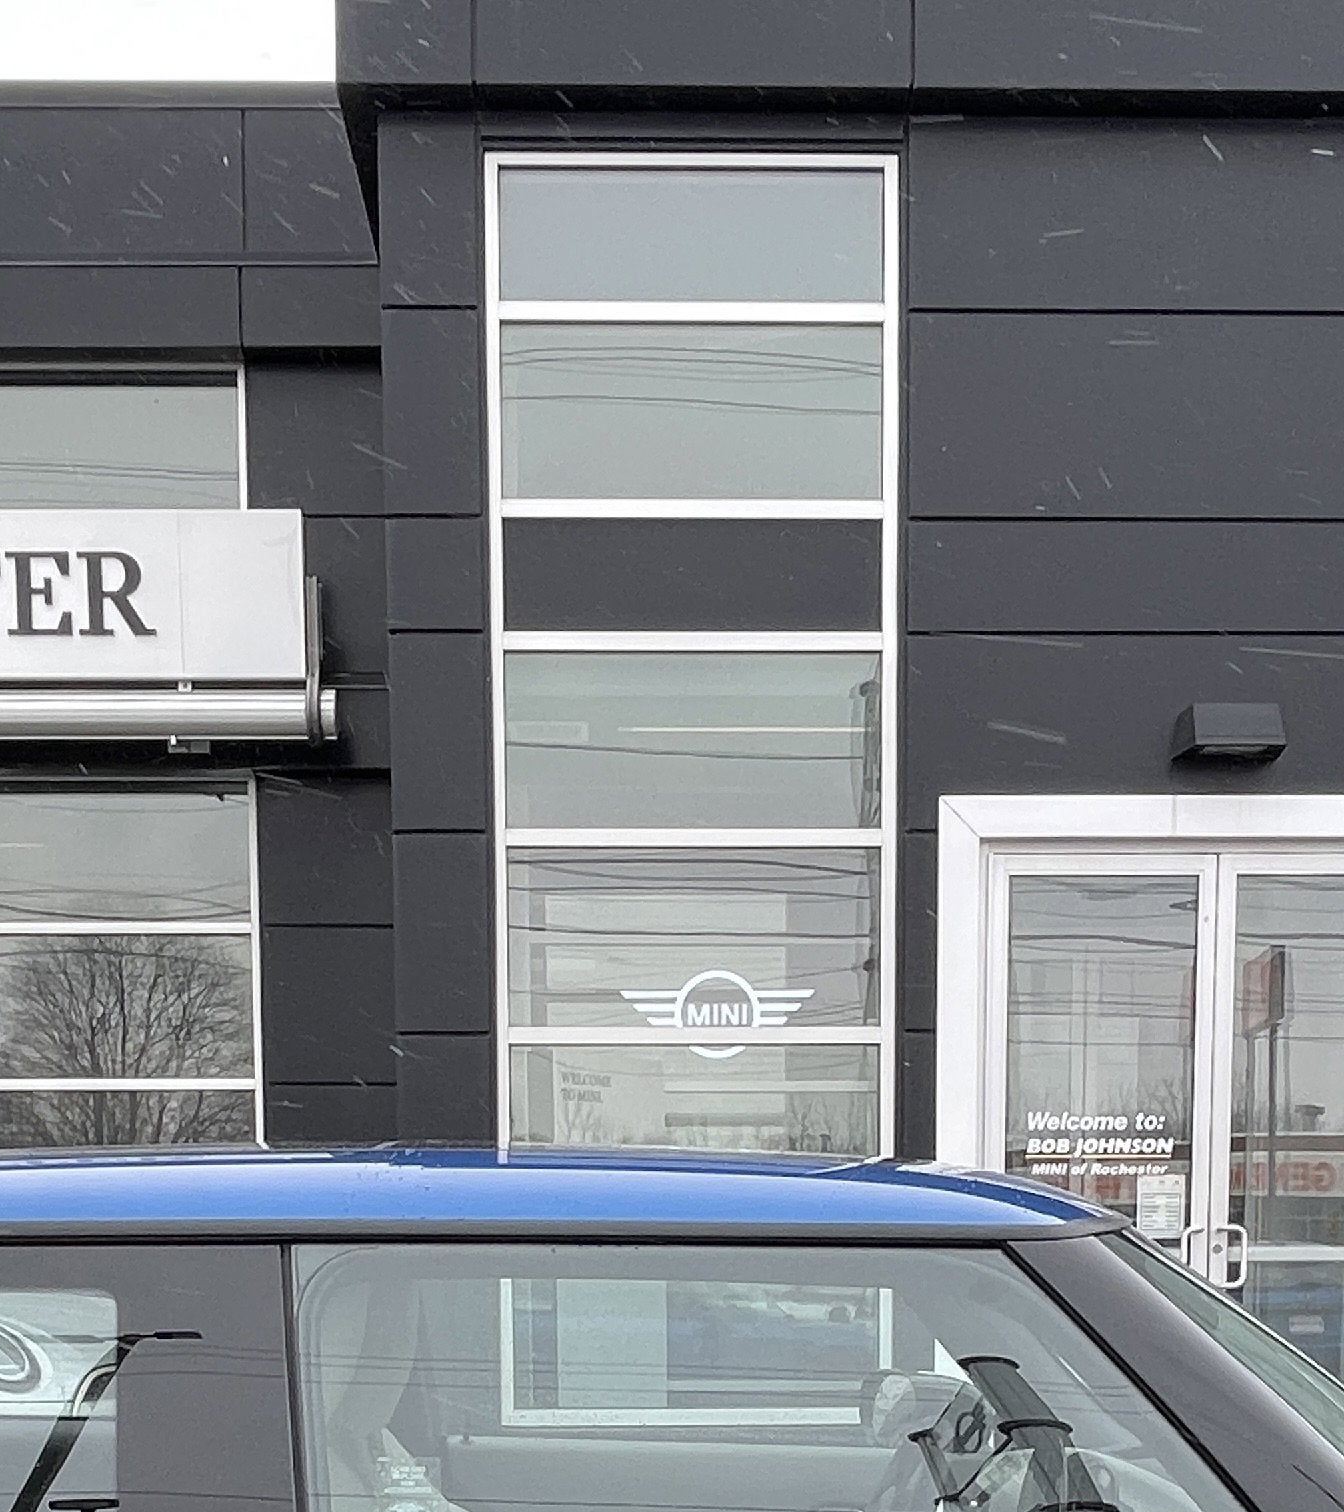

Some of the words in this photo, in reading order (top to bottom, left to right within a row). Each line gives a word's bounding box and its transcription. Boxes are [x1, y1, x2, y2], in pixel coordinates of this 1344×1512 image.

[687, 1003, 748, 1026] MINI
[1027, 1111, 1128, 1131] Welcome
[1135, 1111, 1166, 1131] to:
[1026, 1138, 1070, 1154] BOB
[1073, 1136, 1174, 1158] JOHNSON
[1031, 1163, 1068, 1175] MINI
[1070, 1163, 1088, 1175] of
[1090, 1162, 1168, 1175] Rochester
